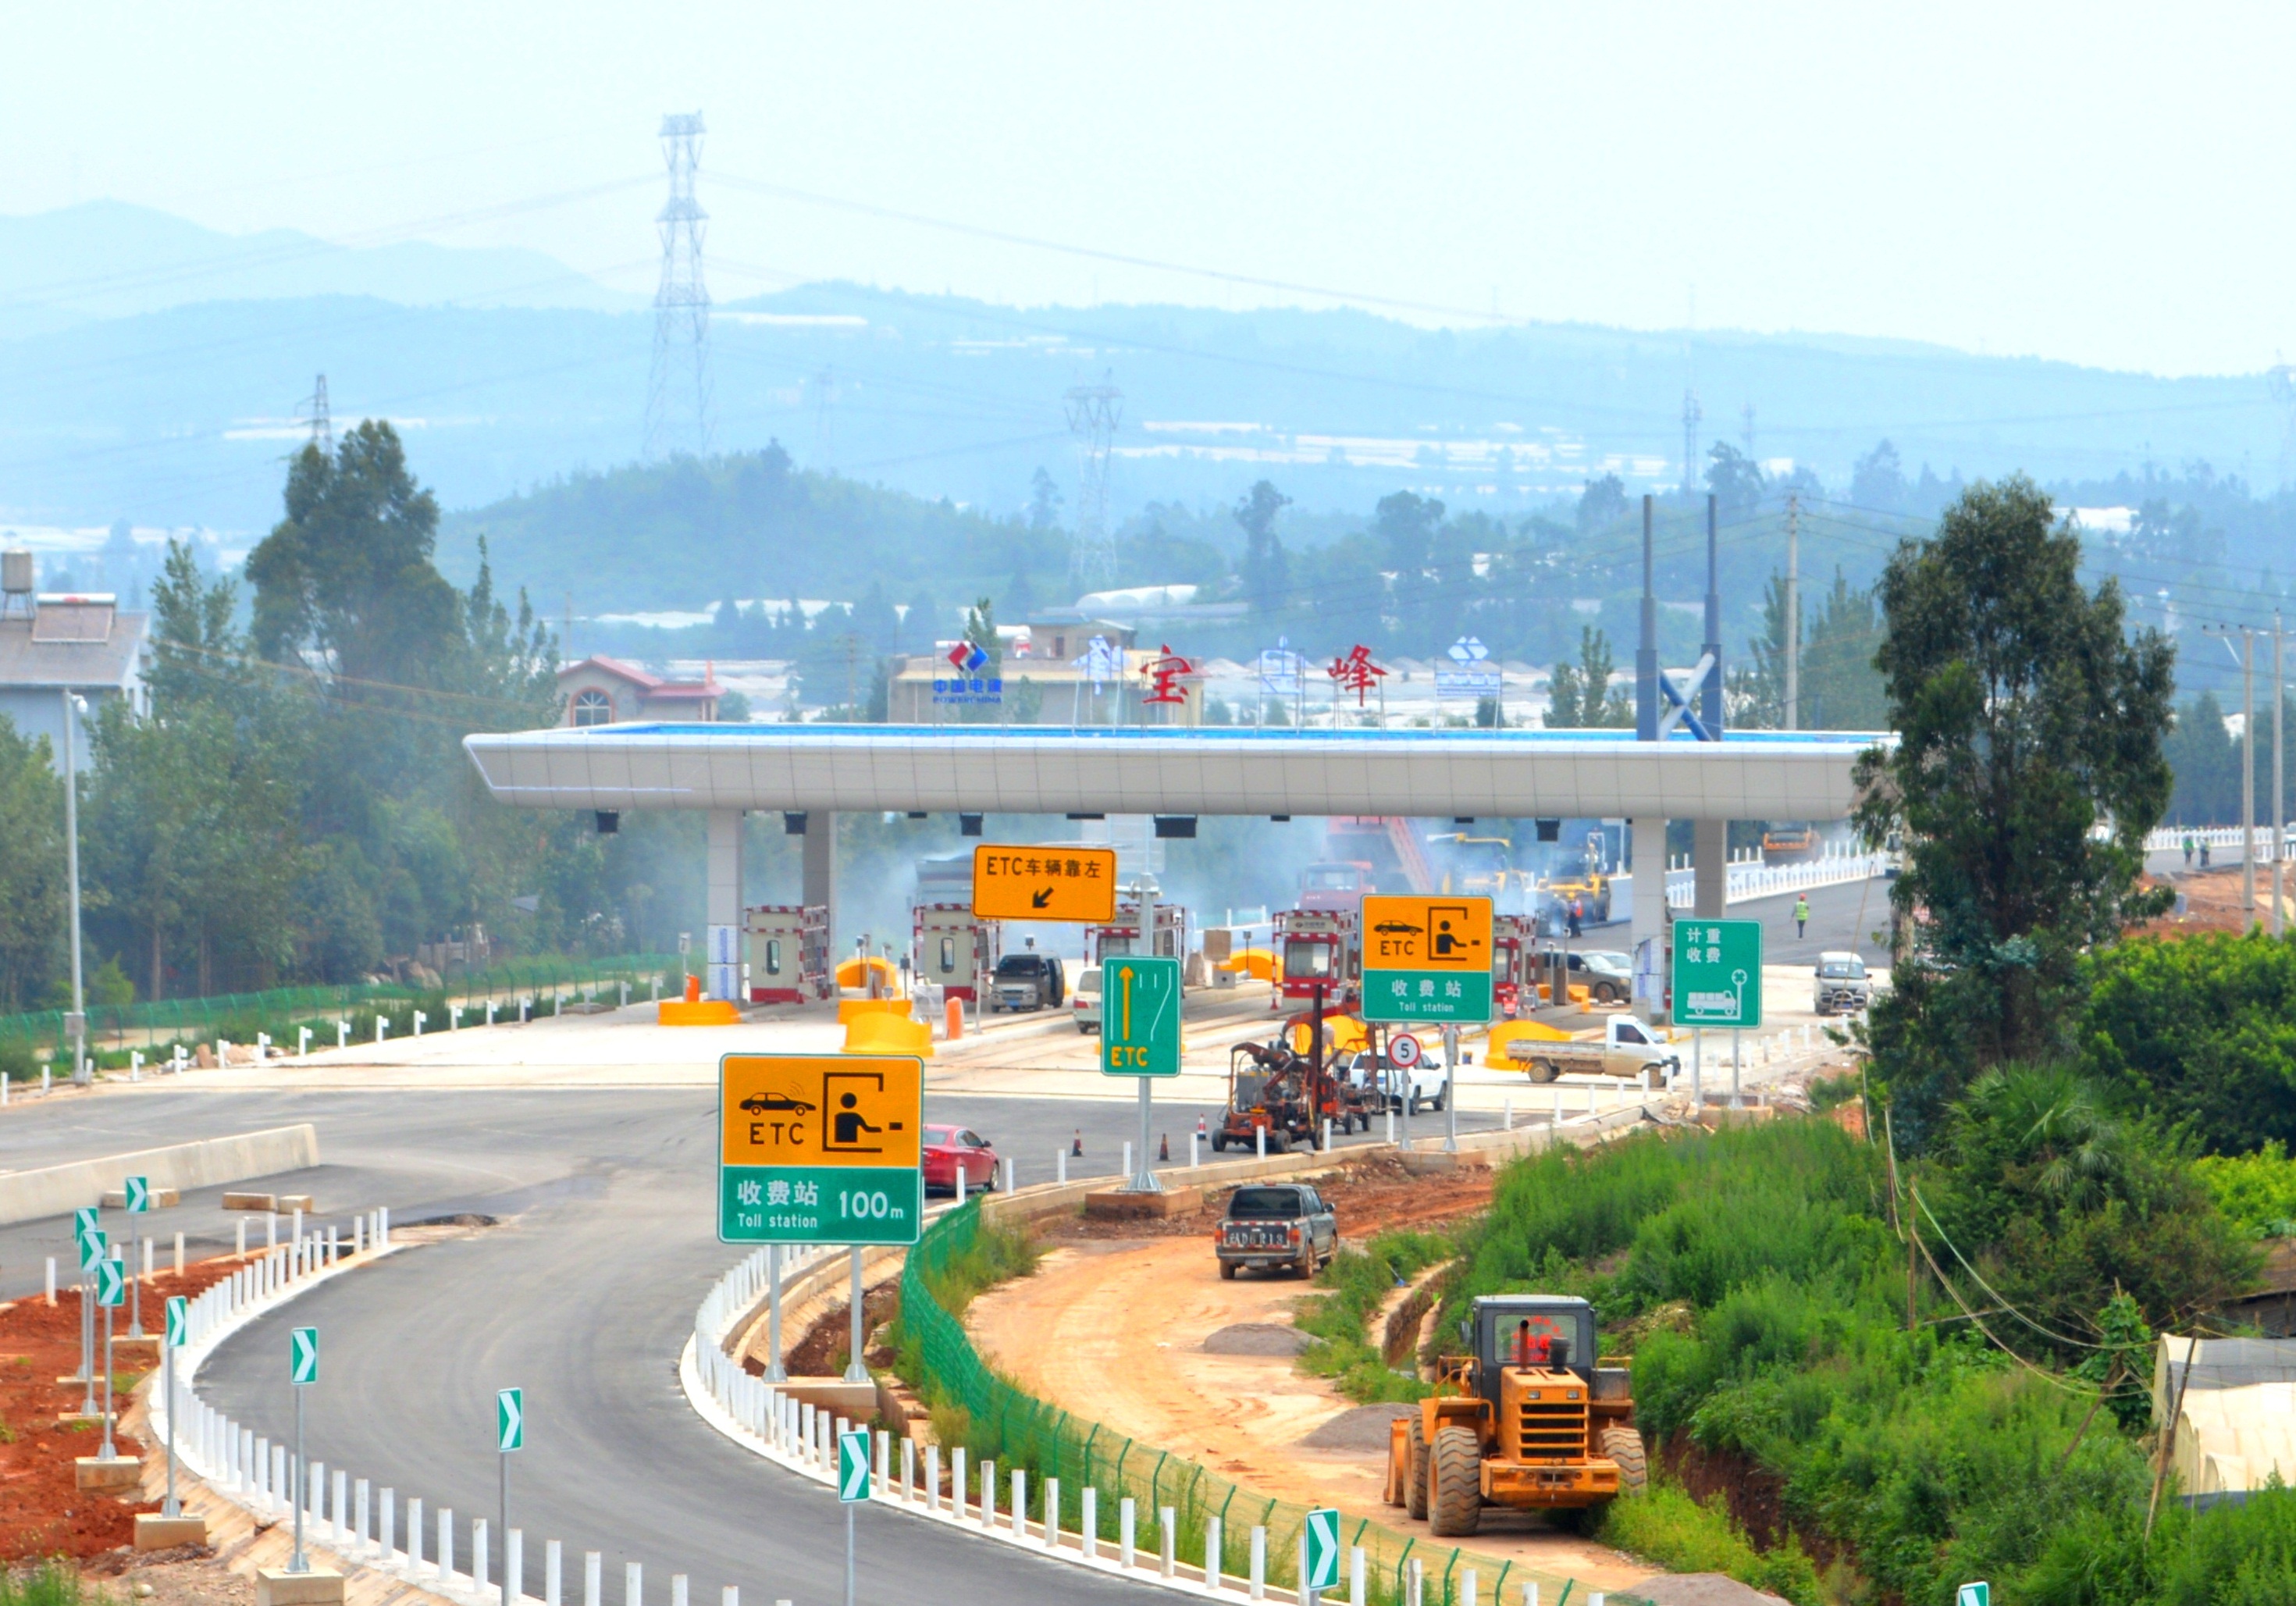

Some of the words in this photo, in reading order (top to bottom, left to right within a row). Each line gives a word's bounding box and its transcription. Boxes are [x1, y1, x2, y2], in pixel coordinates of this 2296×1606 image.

[1686, 927, 1721, 944] 计重
[1380, 940, 1415, 956] ETC
[1686, 947, 1721, 963] 收费
[1391, 978, 1462, 998] 收费站
[1399, 1002, 1416, 1012] Toll
[1422, 1002, 1454, 1013] station
[1111, 1046, 1148, 1067] ETC
[1400, 1043, 1410, 1059] 5
[749, 1122, 804, 1145] ETC
[737, 1180, 819, 1206] 收费站
[839, 1191, 904, 1219] 100m
[737, 1213, 762, 1228] Toll
[769, 1213, 817, 1228] station
